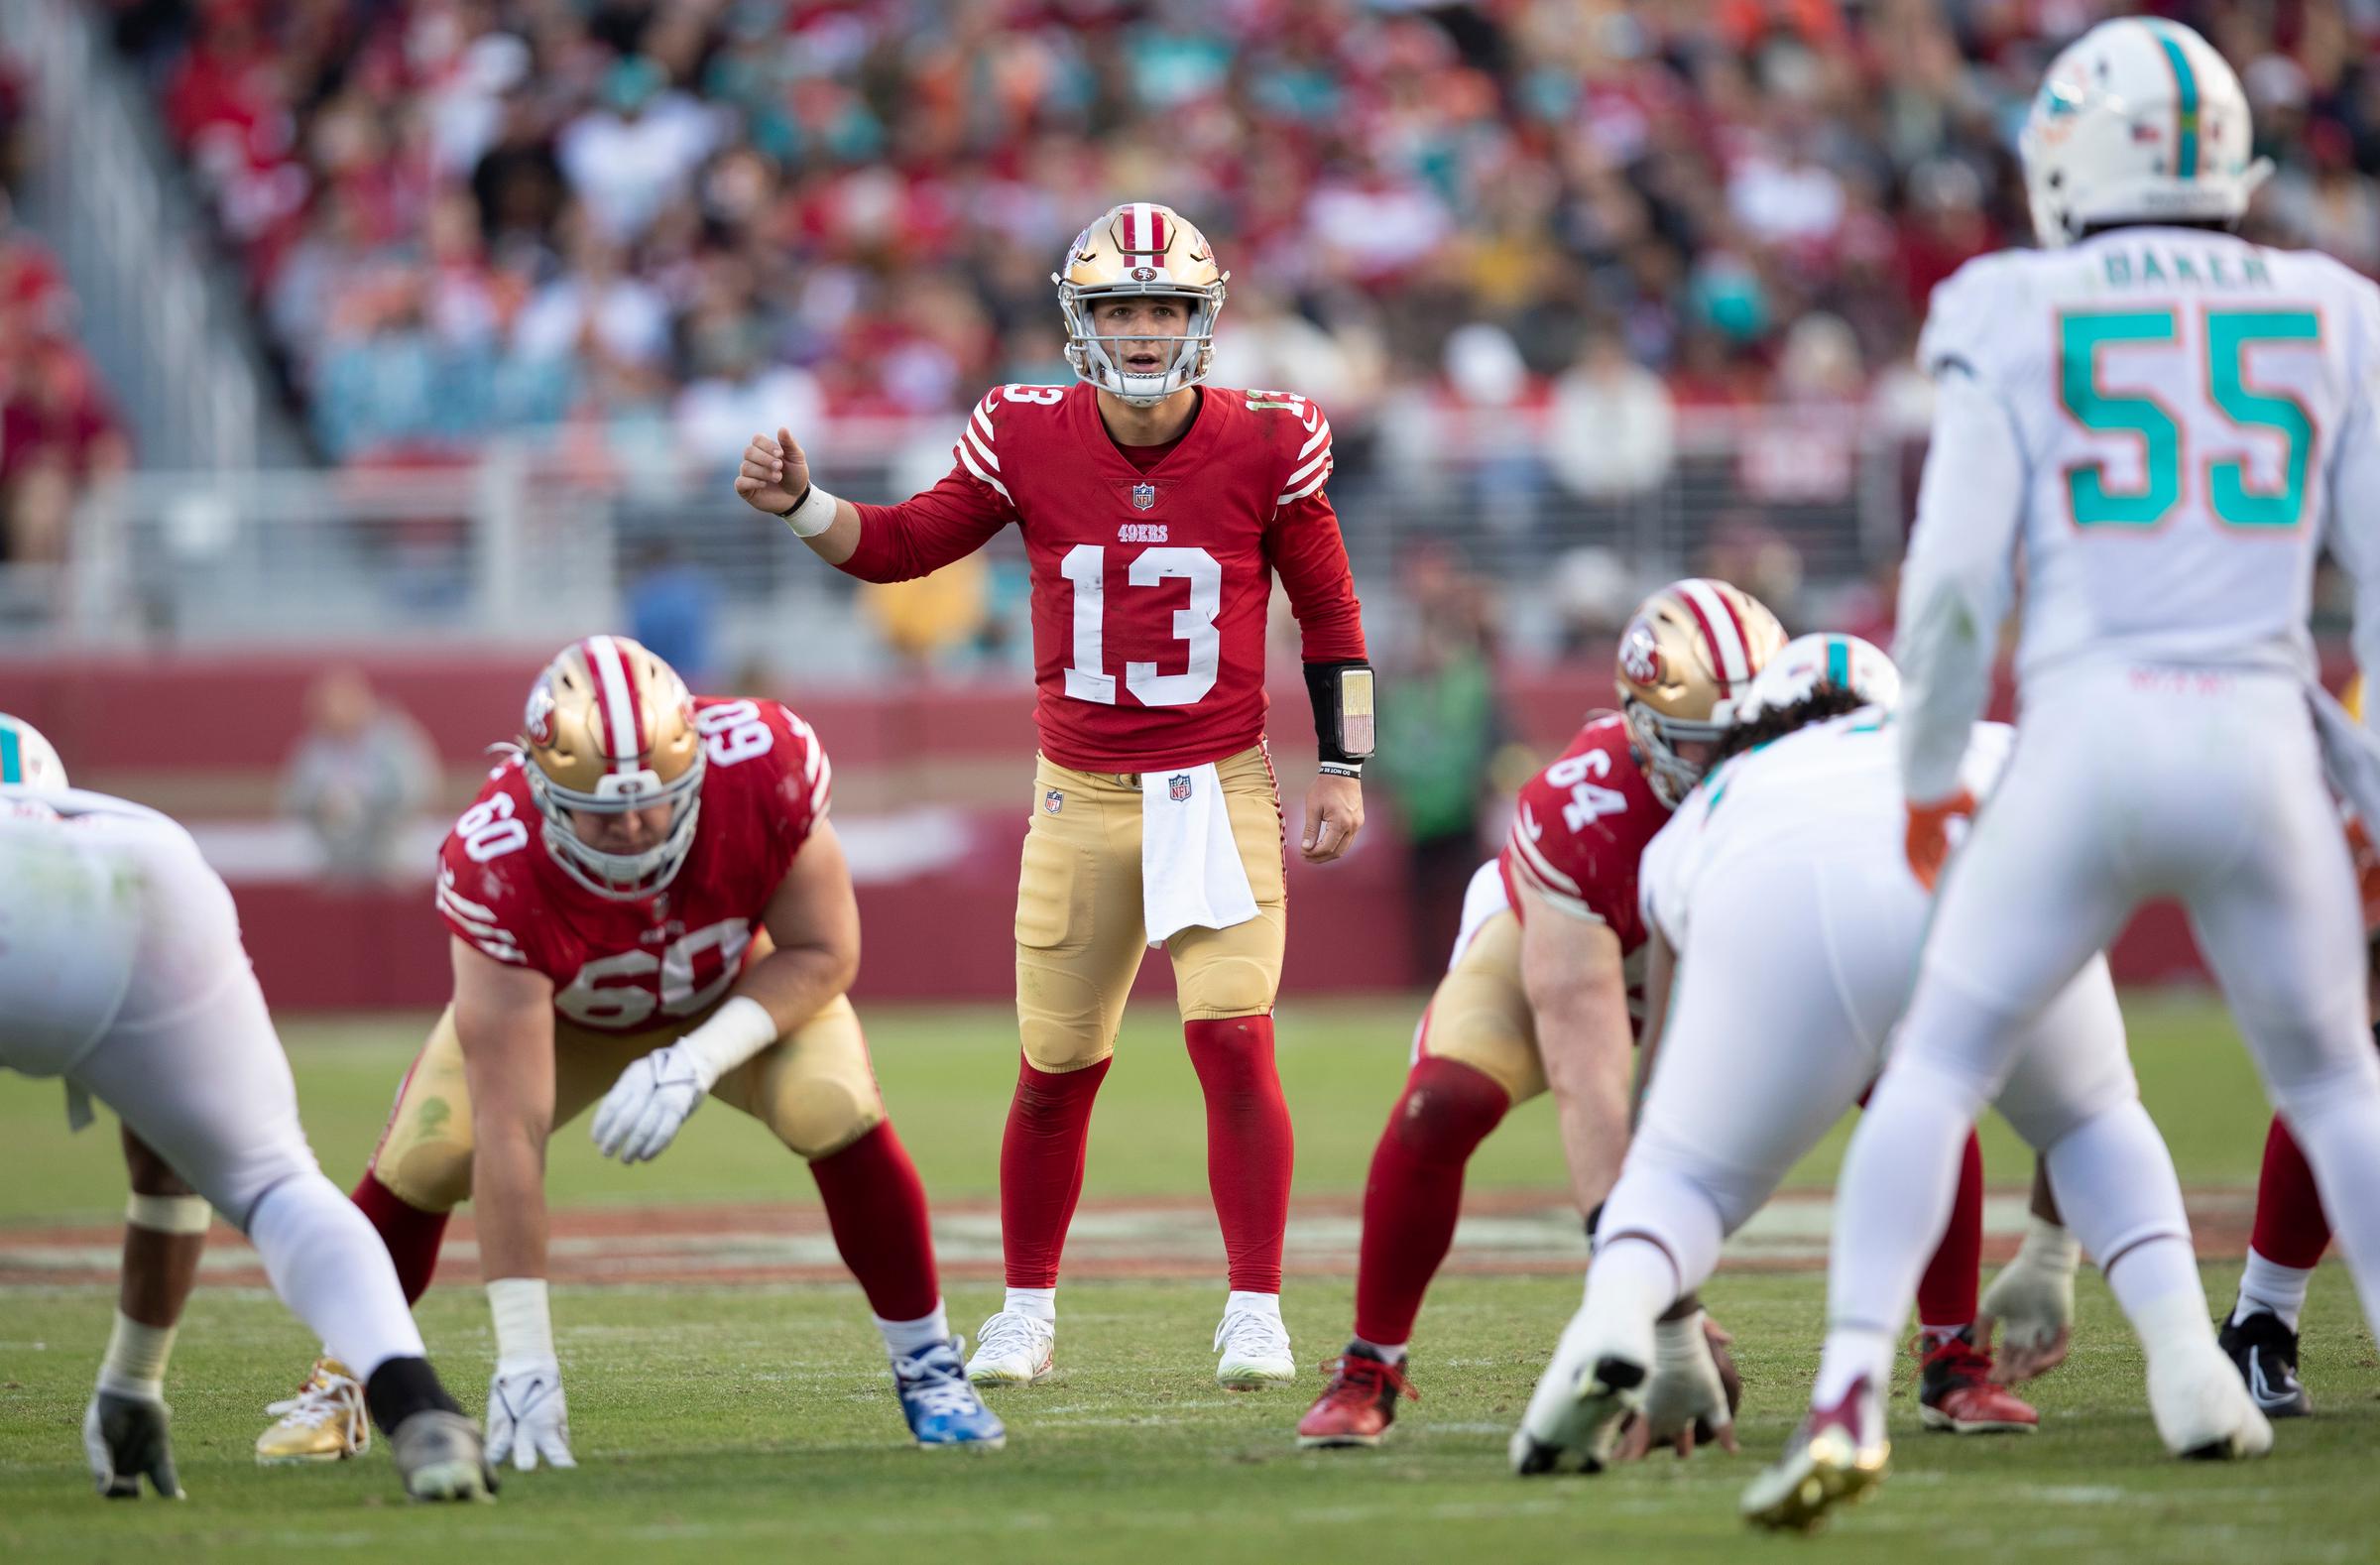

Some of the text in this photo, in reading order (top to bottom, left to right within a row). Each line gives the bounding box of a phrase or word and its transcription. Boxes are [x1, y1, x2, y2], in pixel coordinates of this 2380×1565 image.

[1003, 383, 1065, 406] 3
[2058, 307, 2324, 532] 55
[1117, 524, 1168, 542] 49ERS
[1135, 495, 1151, 506] NFL
[1061, 543, 1222, 707] 13
[697, 699, 774, 769] 60
[1172, 784, 1190, 799] NFL
[1545, 748, 1628, 833] 64
[455, 791, 529, 863] 60
[554, 916, 751, 1028] 60
